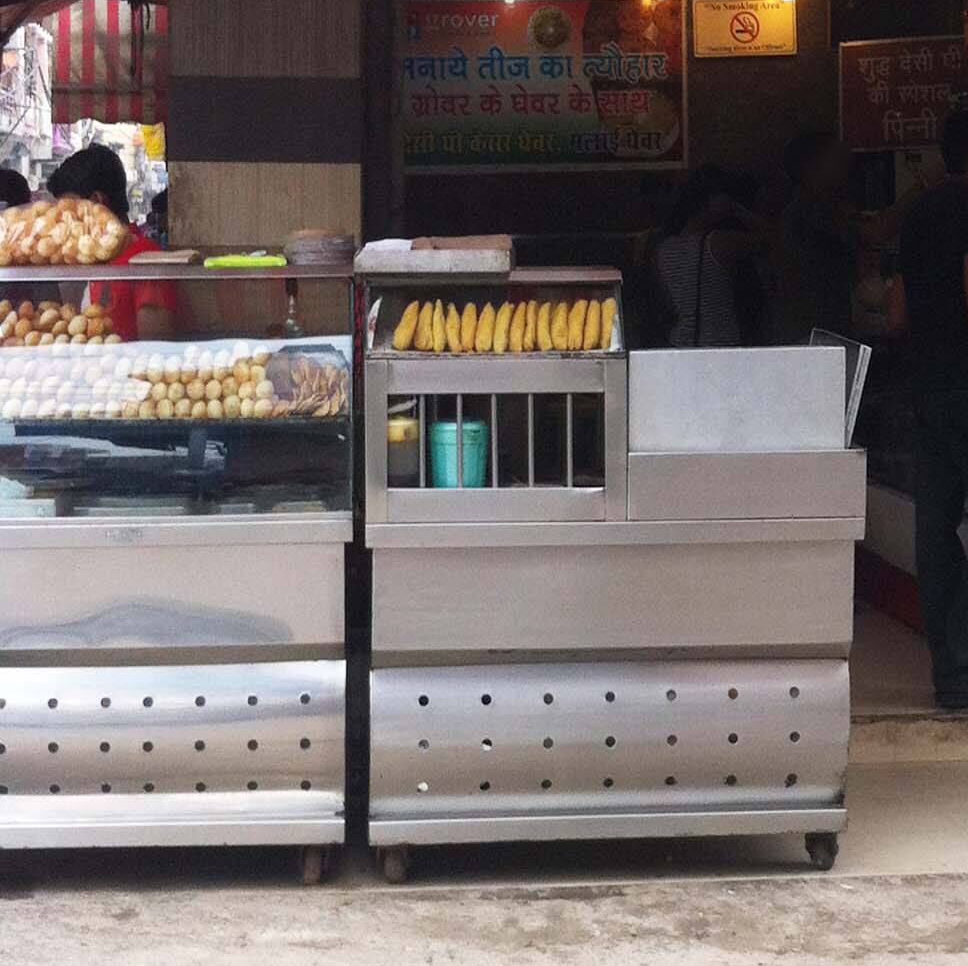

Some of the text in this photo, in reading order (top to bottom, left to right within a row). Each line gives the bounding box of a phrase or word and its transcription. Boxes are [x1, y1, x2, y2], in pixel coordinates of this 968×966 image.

[476, 45, 531, 81] तीज
[538, 53, 574, 80] का
[479, 85, 502, 116] के
[568, 85, 592, 115] के
